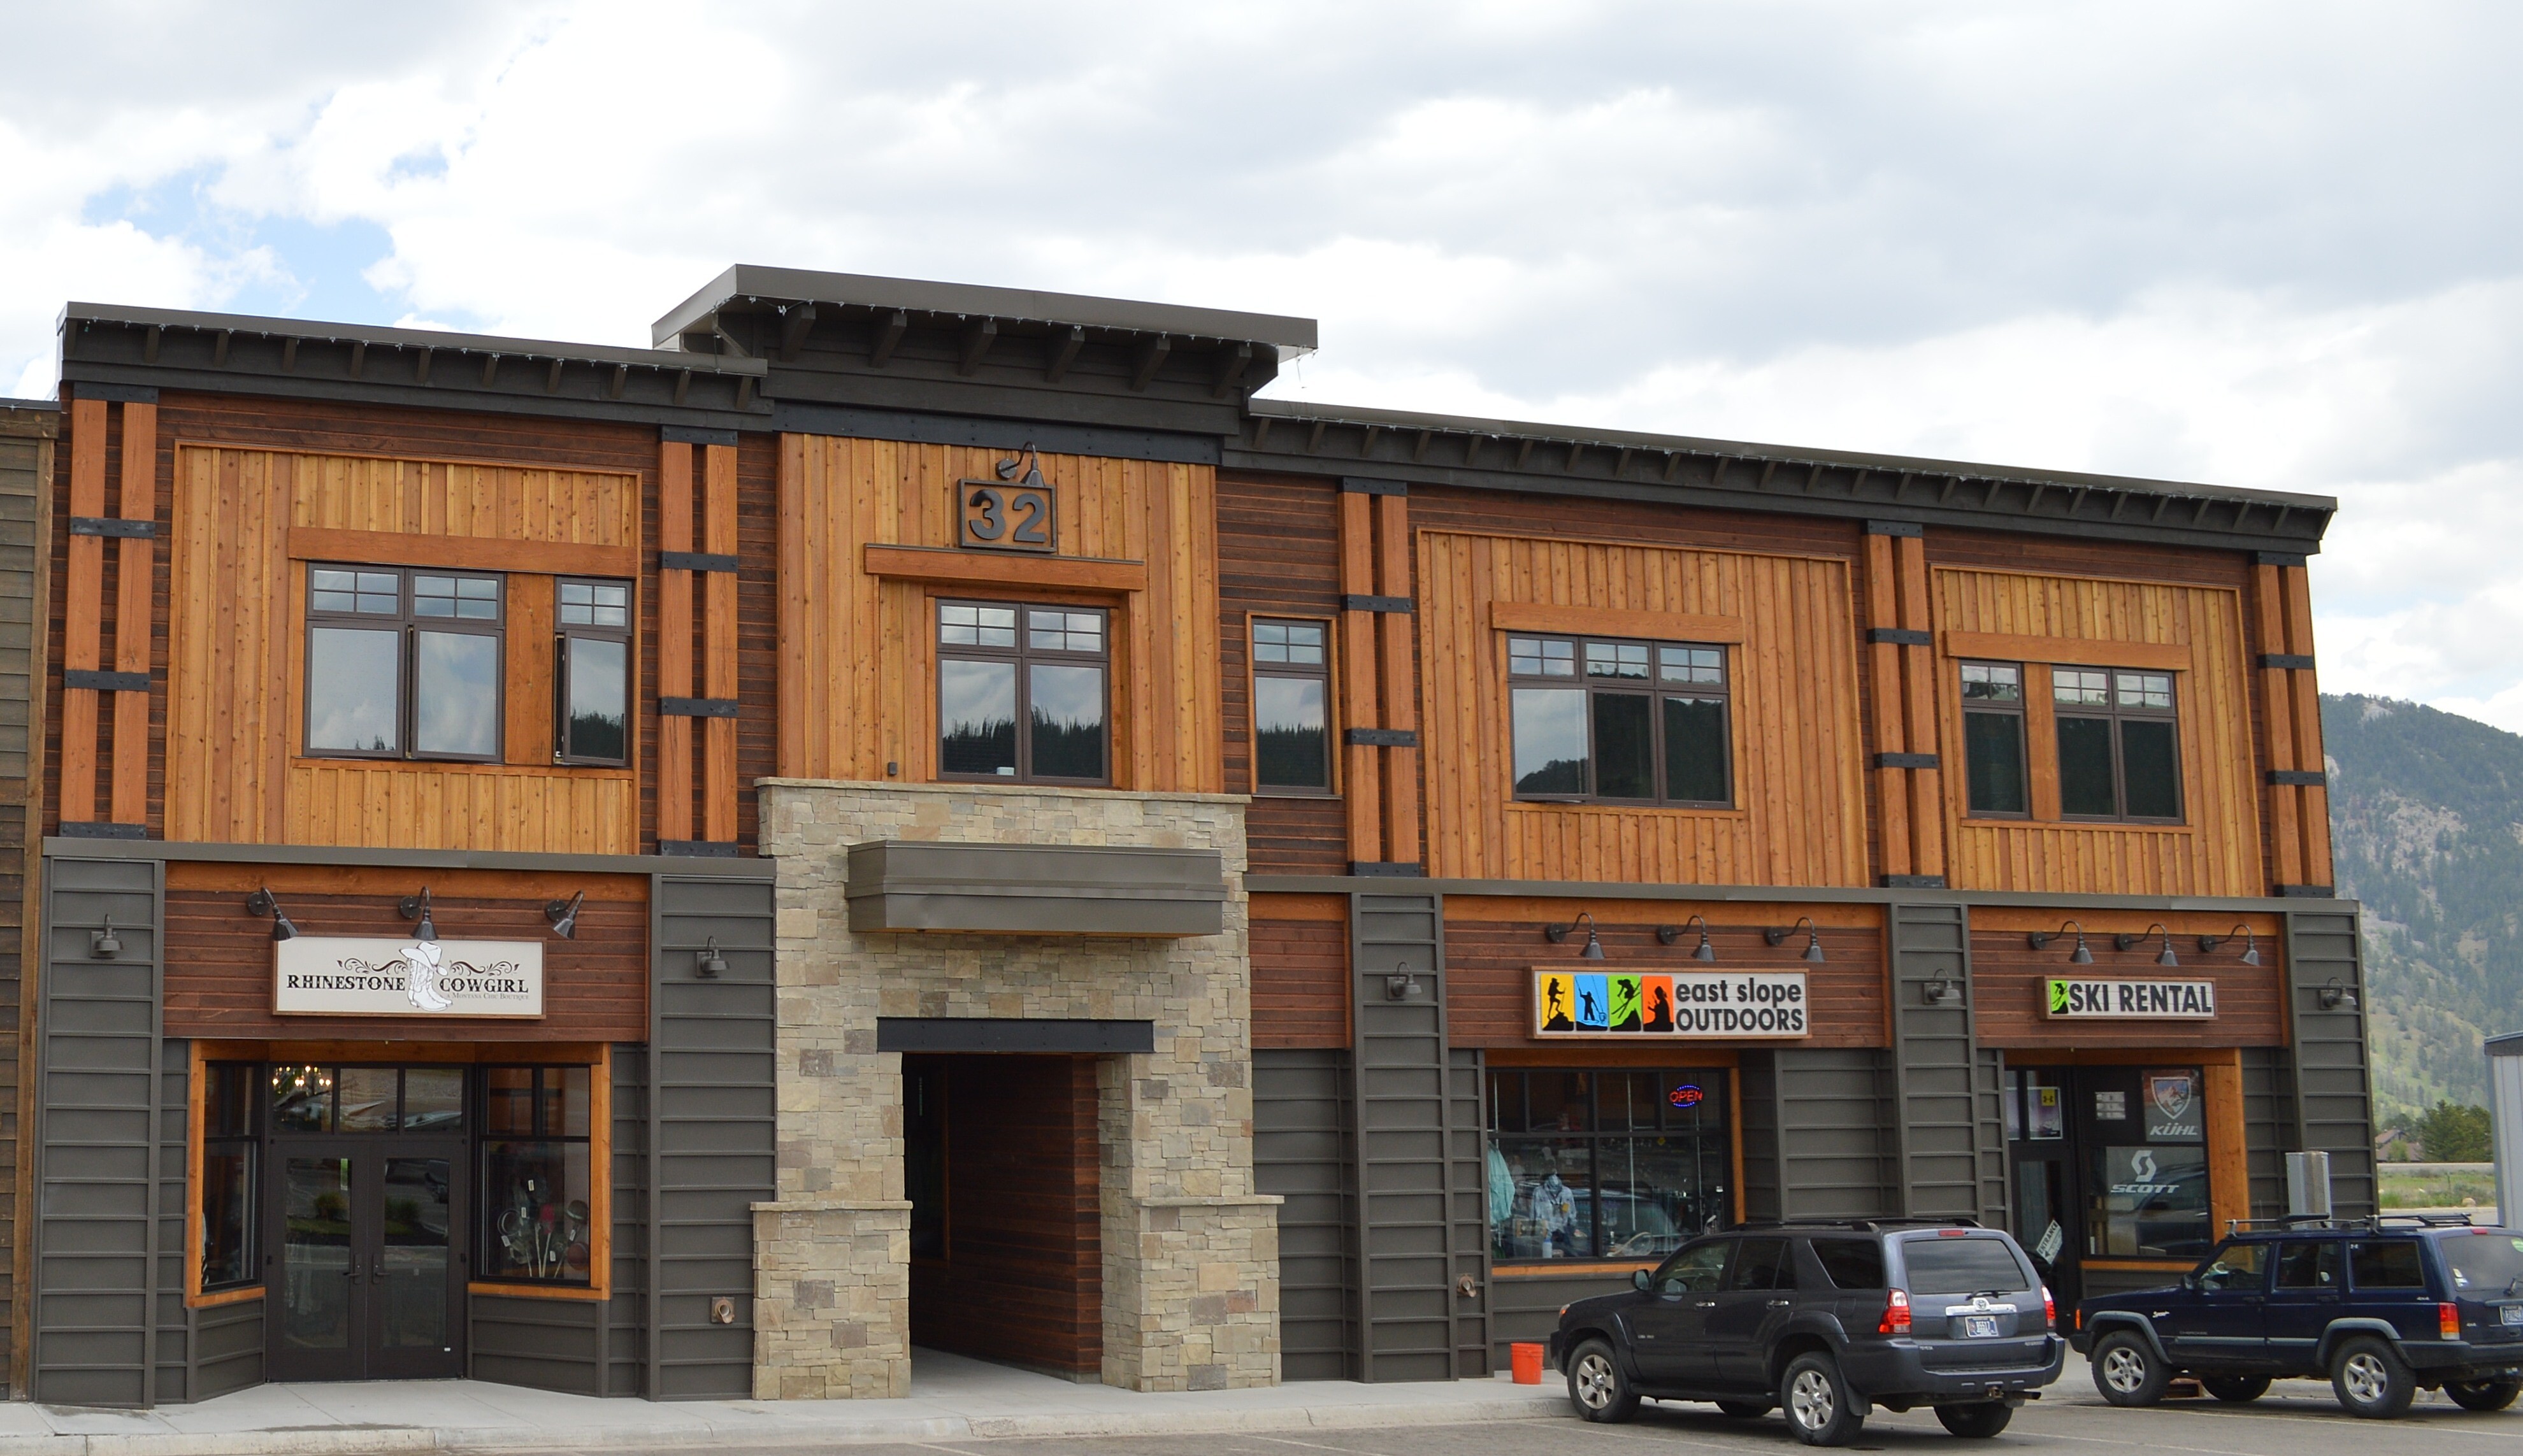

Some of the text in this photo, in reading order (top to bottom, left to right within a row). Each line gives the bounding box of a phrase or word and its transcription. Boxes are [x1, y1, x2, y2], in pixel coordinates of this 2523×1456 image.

[969, 489, 1046, 543] 32
[287, 974, 529, 993] RHINESTONE COWGIRL
[1676, 977, 1801, 1008] east slope
[2069, 983, 2212, 1013] SKI RENTAL
[1676, 1008, 1803, 1031] OUTDOORS
[1669, 1090, 1703, 1103] OPEN
[2150, 1122, 2198, 1136] KÜHL
[2111, 1184, 2180, 1194] SCOTT
[2038, 1222, 2058, 1254] ENTRANCE
